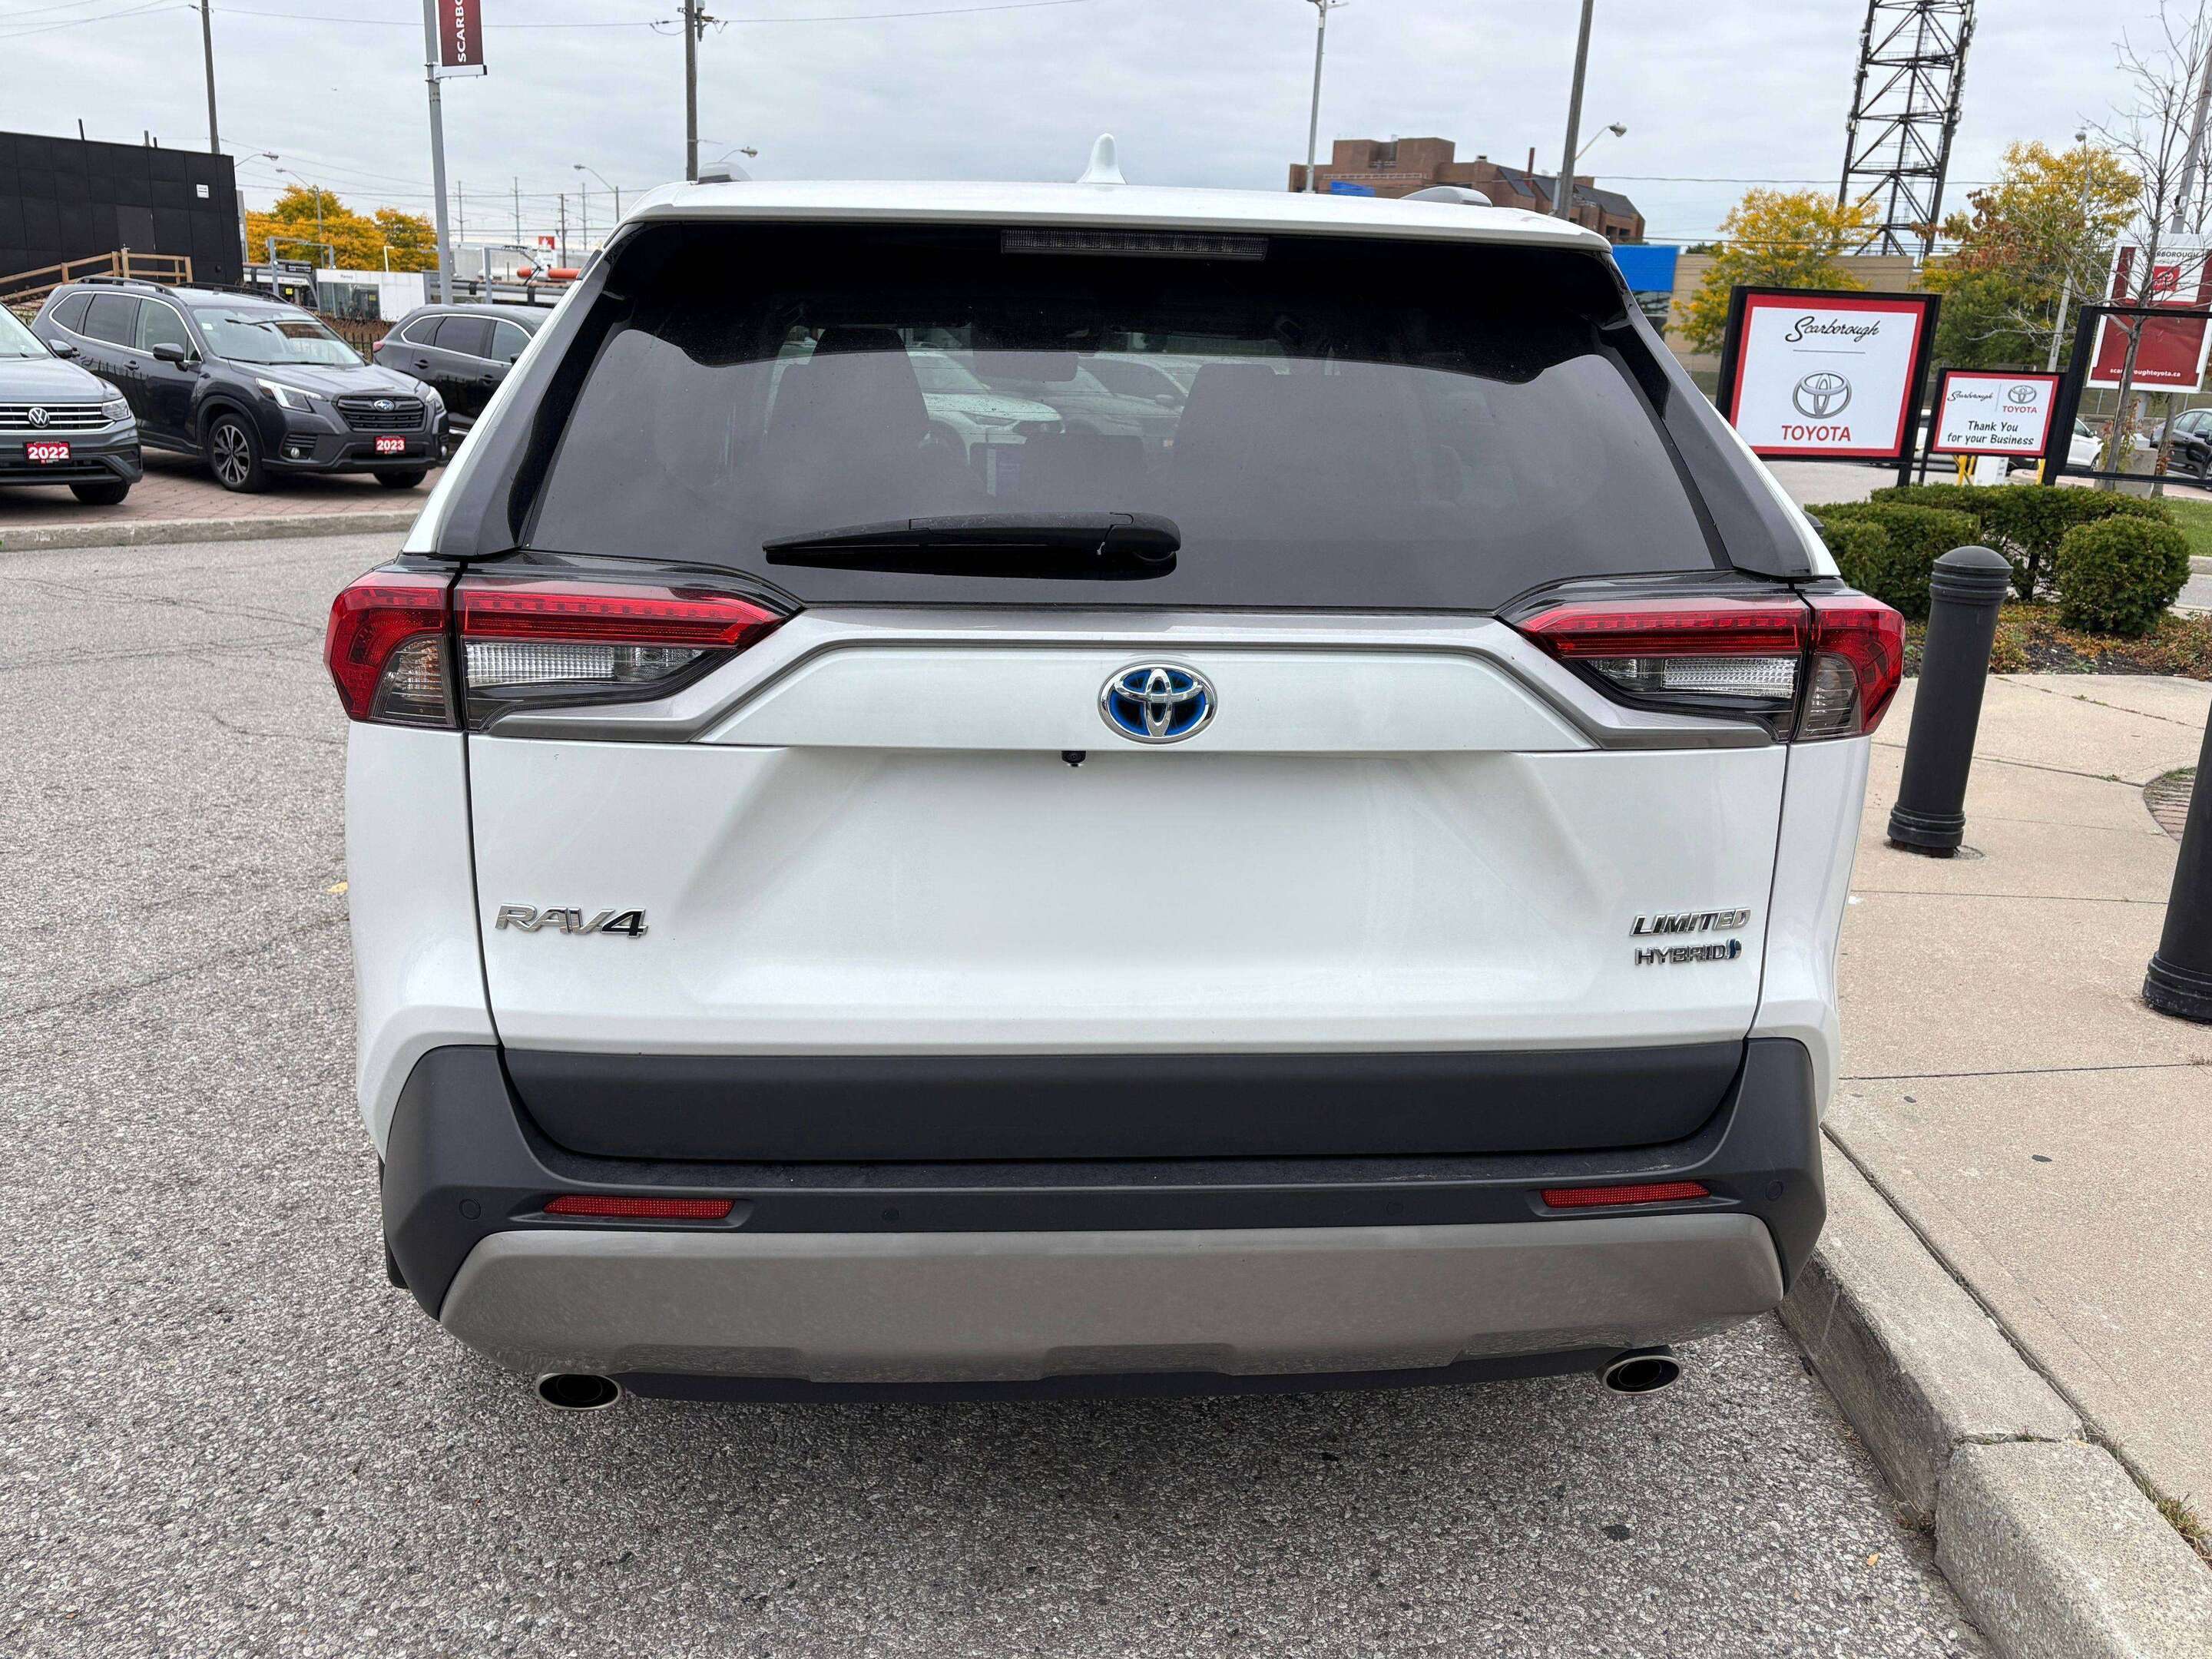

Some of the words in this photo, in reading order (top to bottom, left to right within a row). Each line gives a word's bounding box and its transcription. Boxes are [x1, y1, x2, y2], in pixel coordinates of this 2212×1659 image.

[1785, 316, 1880, 343] Scarborough
[2110, 368, 2181, 377] scaroughtoyota.ca
[2003, 405, 2038, 414] TOYOTA
[1968, 420, 1997, 432] Thank
[2001, 422, 2018, 432] You
[1781, 425, 1852, 442] TOYOTA
[1947, 432, 1963, 442] for
[1965, 435, 1988, 445] your
[1990, 434, 2034, 445] Business
[376, 439, 405, 451] 2023
[28, 446, 70, 460] 2022
[495, 903, 649, 939] RAV4
[1629, 907, 1752, 937] LIMITED
[1634, 944, 1727, 965] HYBRID
